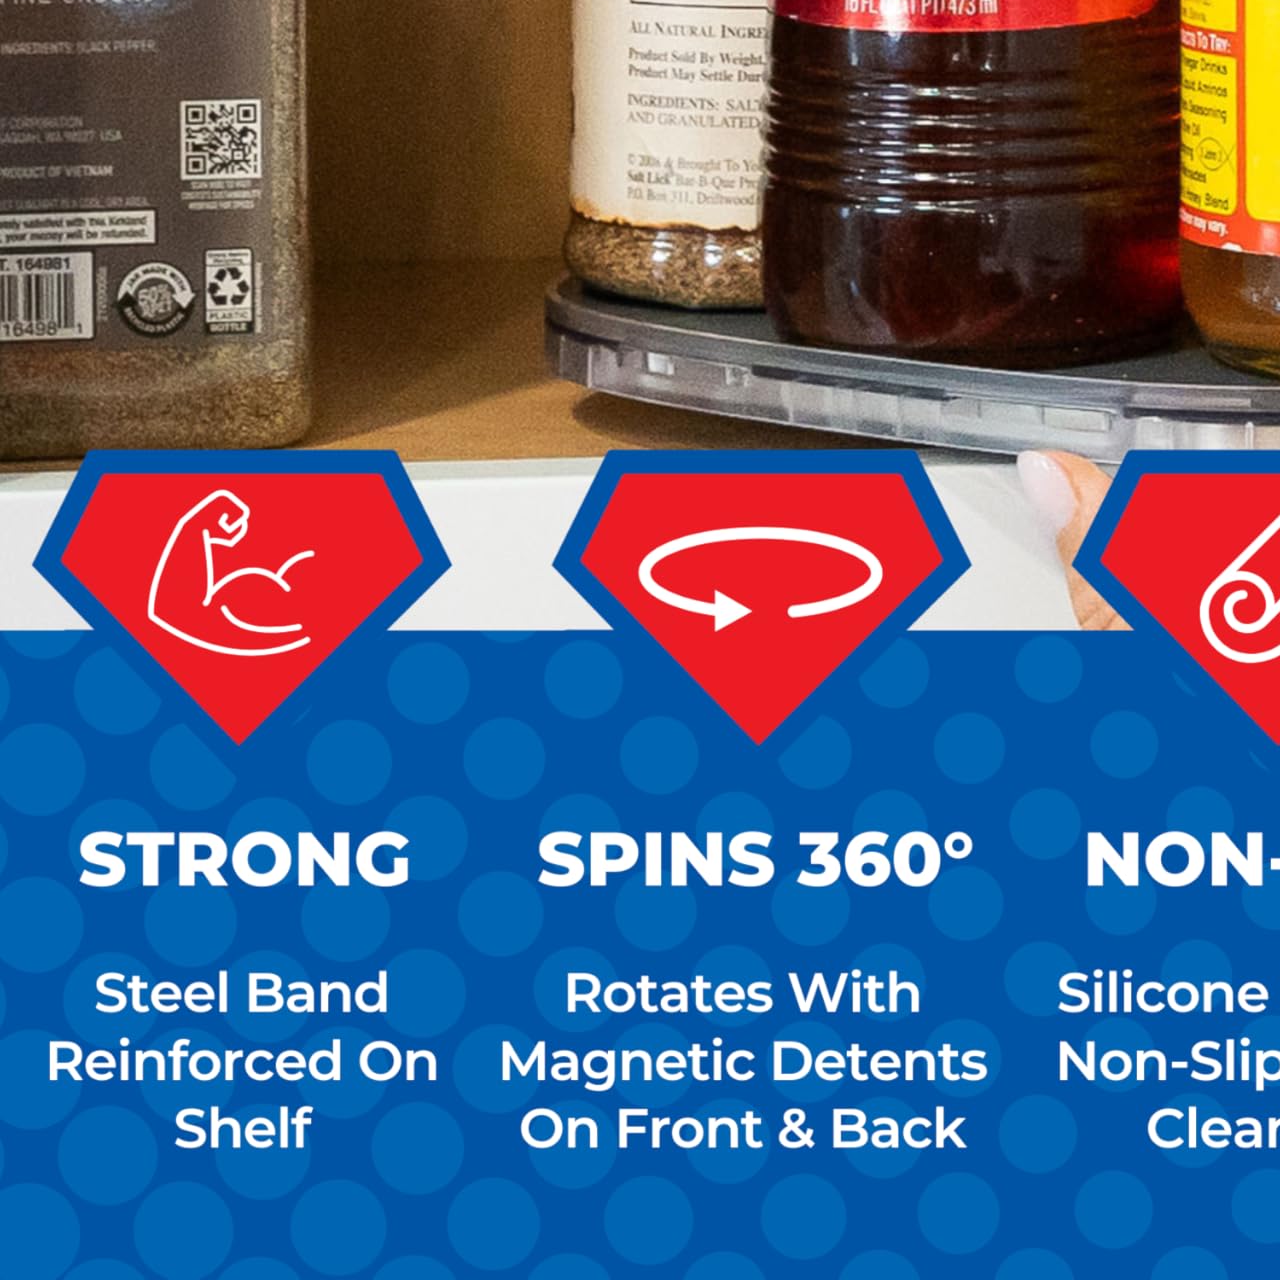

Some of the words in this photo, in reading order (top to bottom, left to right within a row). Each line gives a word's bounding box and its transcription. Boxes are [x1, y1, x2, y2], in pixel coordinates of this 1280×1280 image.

[631, 19, 651, 35] ALL
[655, 21, 716, 38] NATURAL
[700, 52, 714, 67] By
[672, 68, 695, 83] May
[701, 70, 734, 82] Settle
[628, 93, 720, 111] INGREDIENTS:
[628, 111, 655, 125] AND
[658, 112, 761, 128] GRANULATED
[209, 311, 248, 320] PLASTIC
[3, 322, 57, 337] 16498
